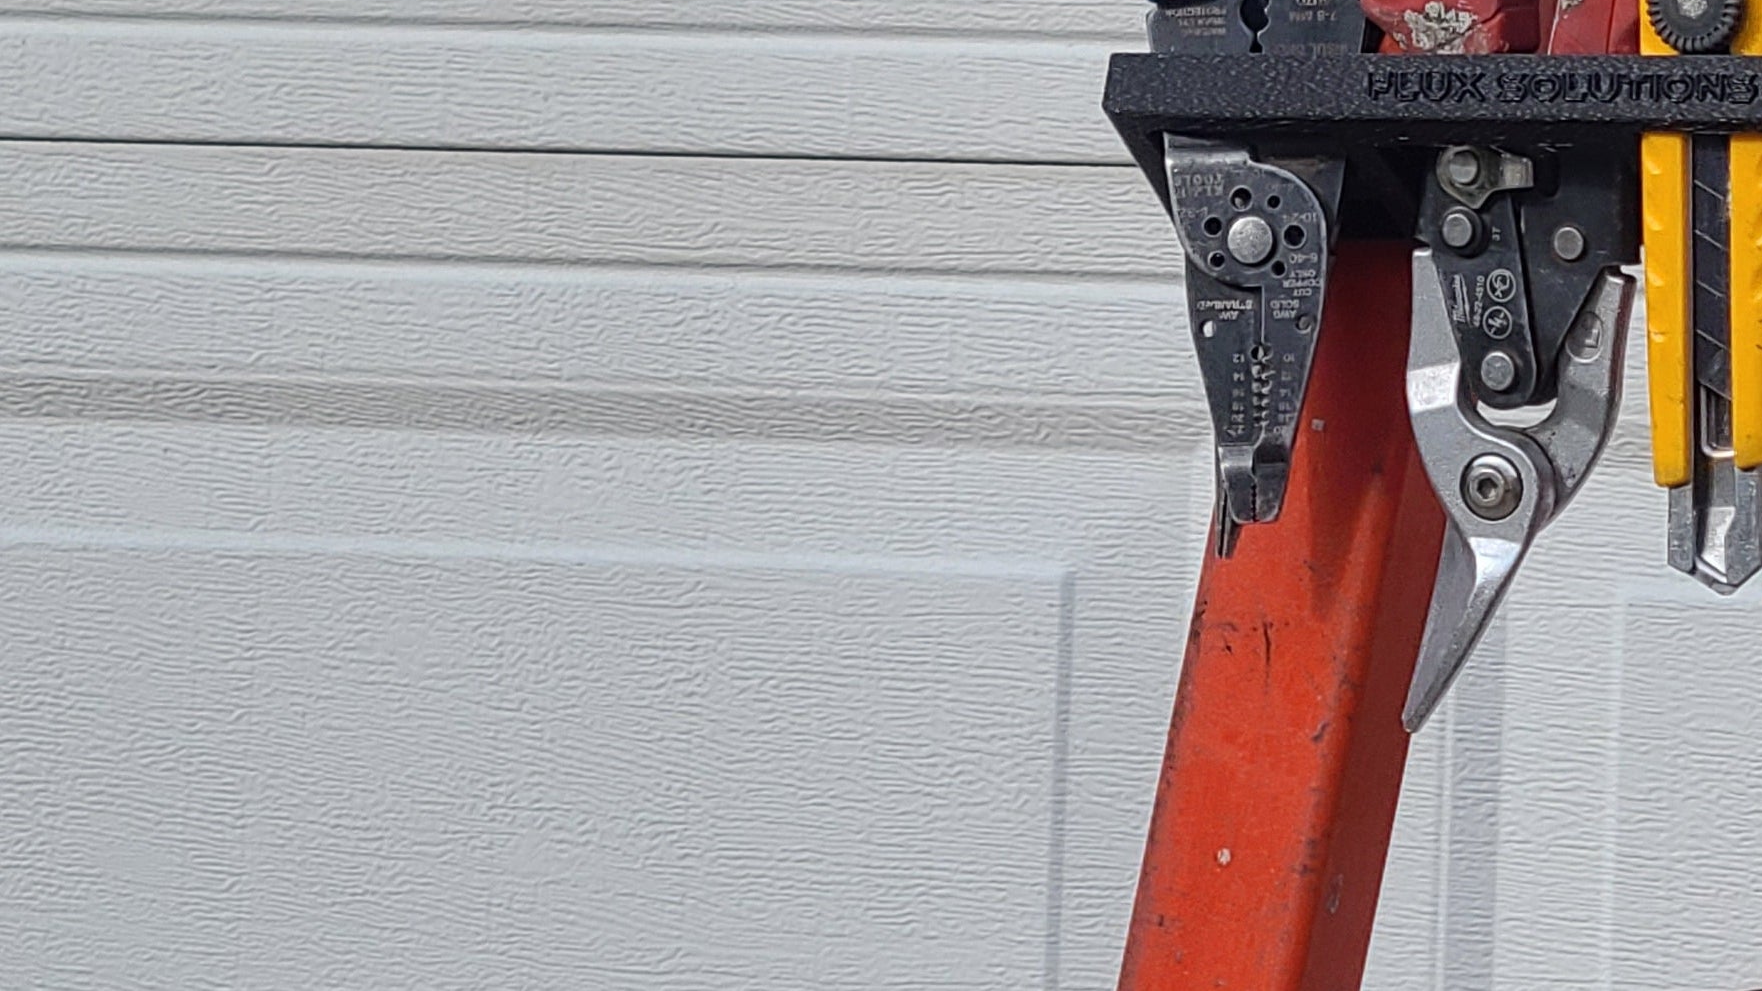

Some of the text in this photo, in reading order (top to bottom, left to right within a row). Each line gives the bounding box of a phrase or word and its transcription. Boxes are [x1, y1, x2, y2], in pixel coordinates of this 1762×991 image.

[1367, 71, 1760, 105] FLUX SOLUTIONS
[1282, 279, 1321, 288] COPPER
[1292, 288, 1312, 297] CUT
[1451, 273, 1468, 324] Milwaukee
[1270, 299, 1299, 308] SOLID
[1272, 309, 1297, 318] AWG
[1232, 354, 1245, 363] 12
